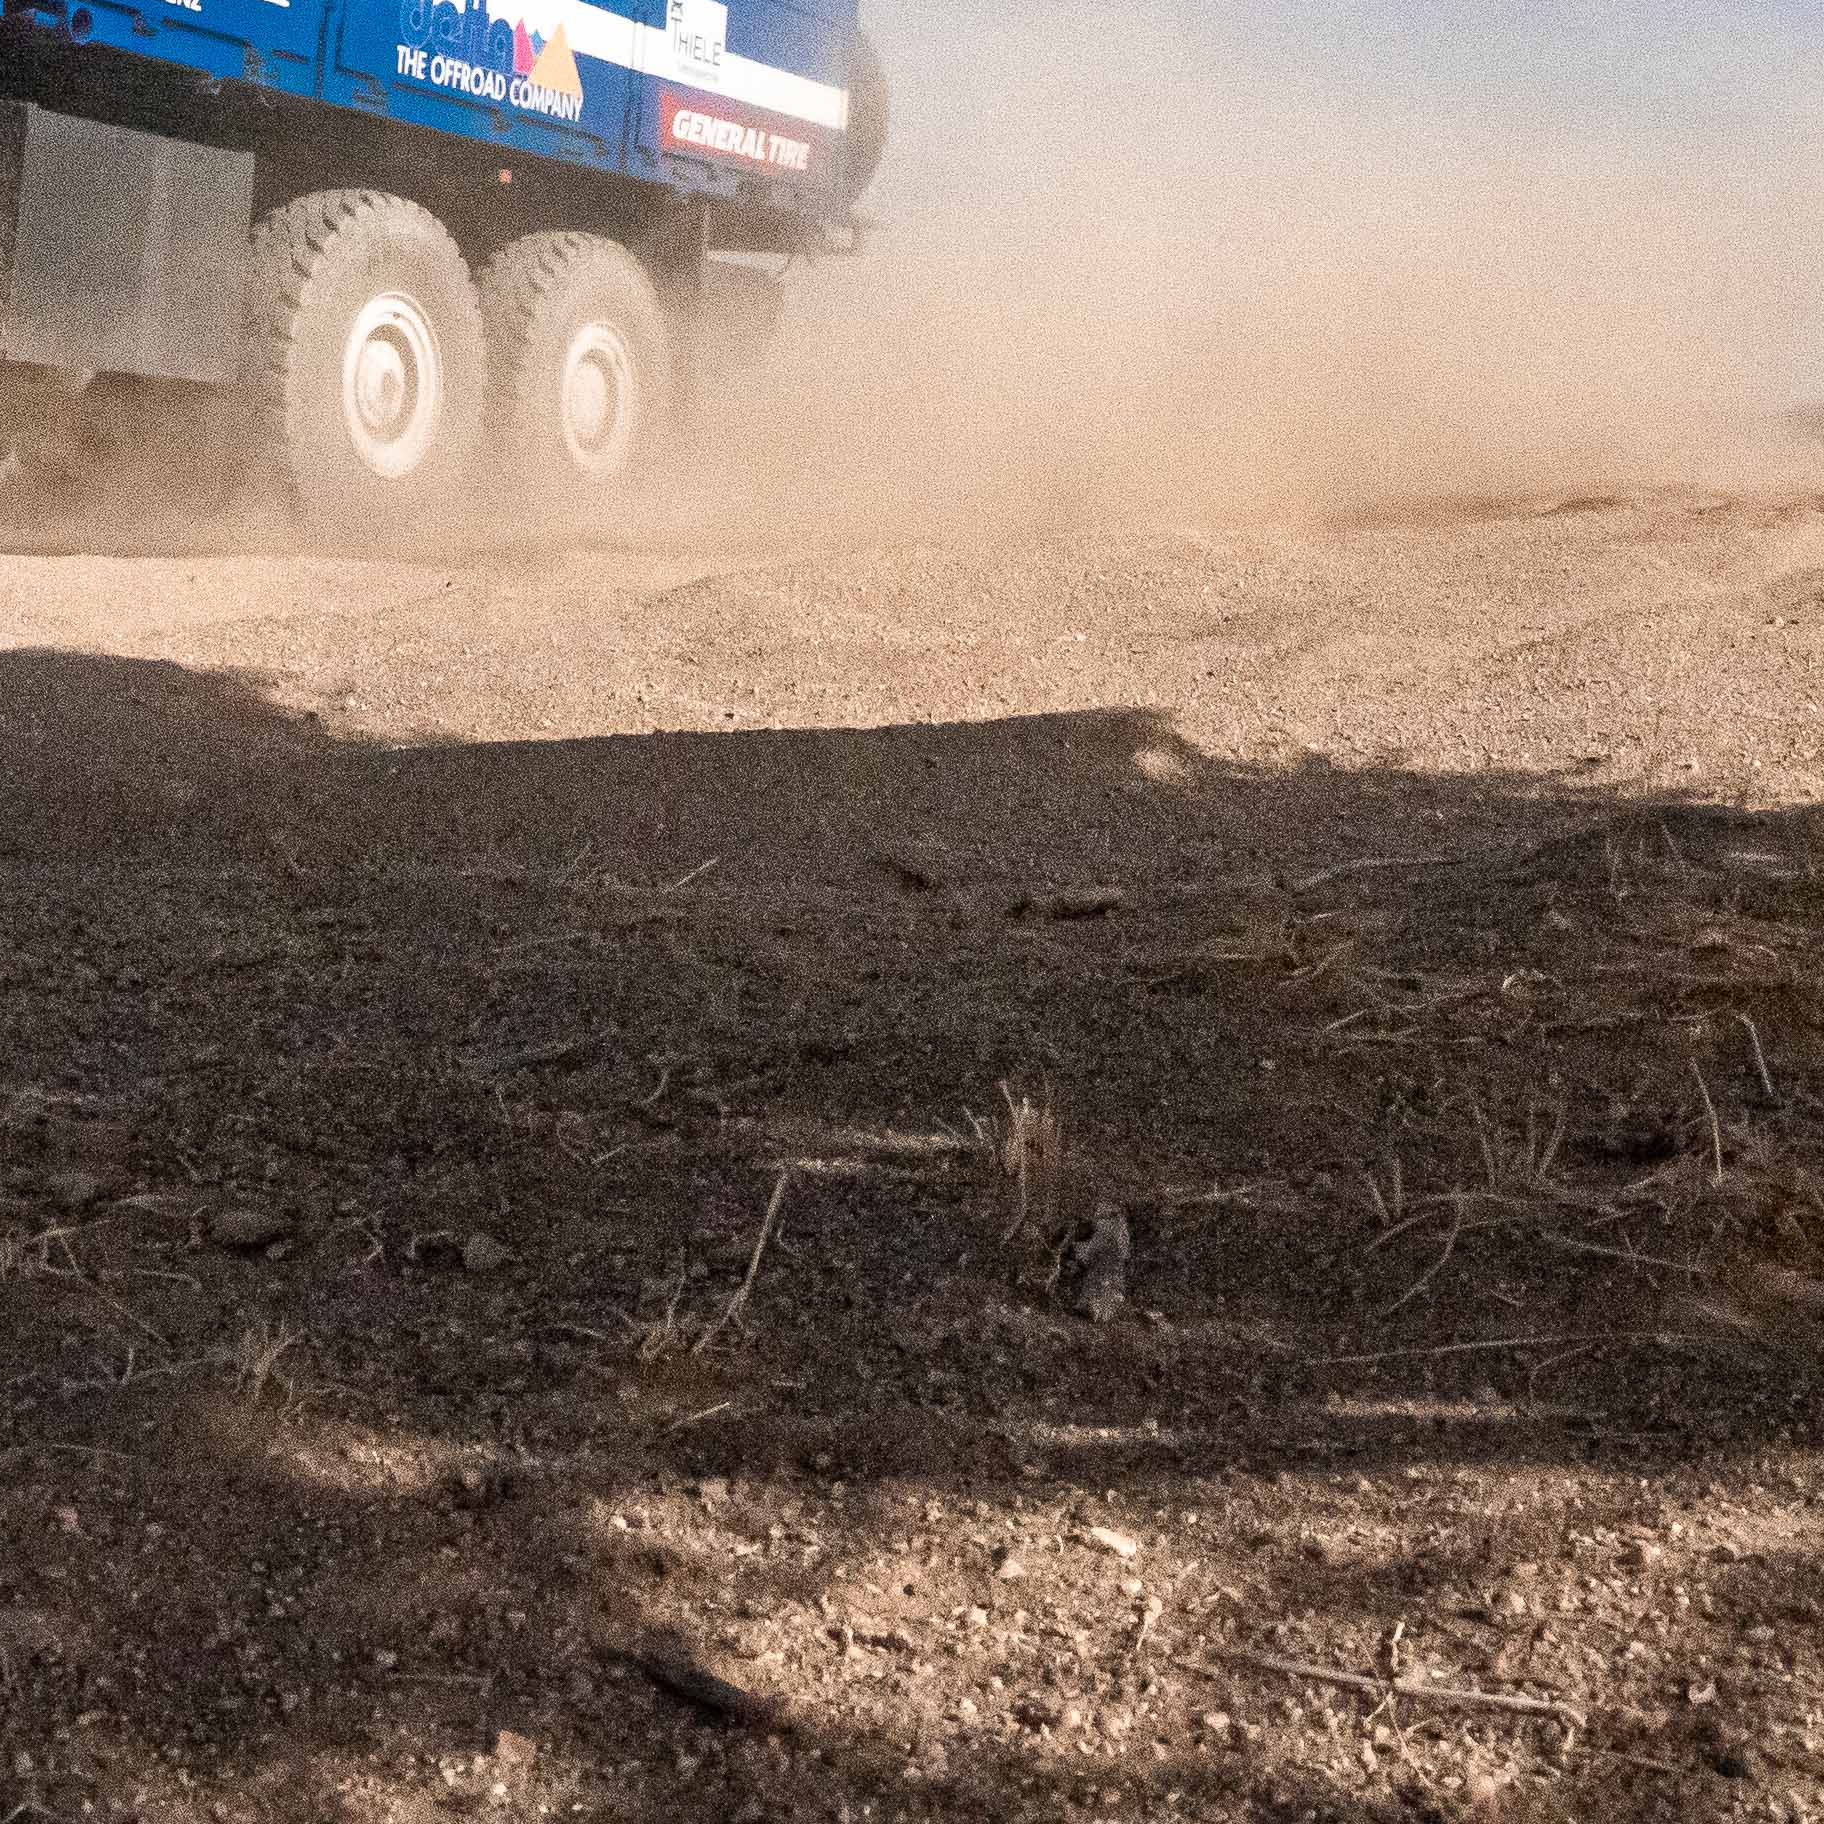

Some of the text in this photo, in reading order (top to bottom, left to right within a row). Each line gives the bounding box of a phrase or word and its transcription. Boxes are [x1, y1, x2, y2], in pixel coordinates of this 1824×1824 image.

[396, 45, 584, 122] THE OFFROAD COMPANY
[673, 110, 767, 160] GENERAL
